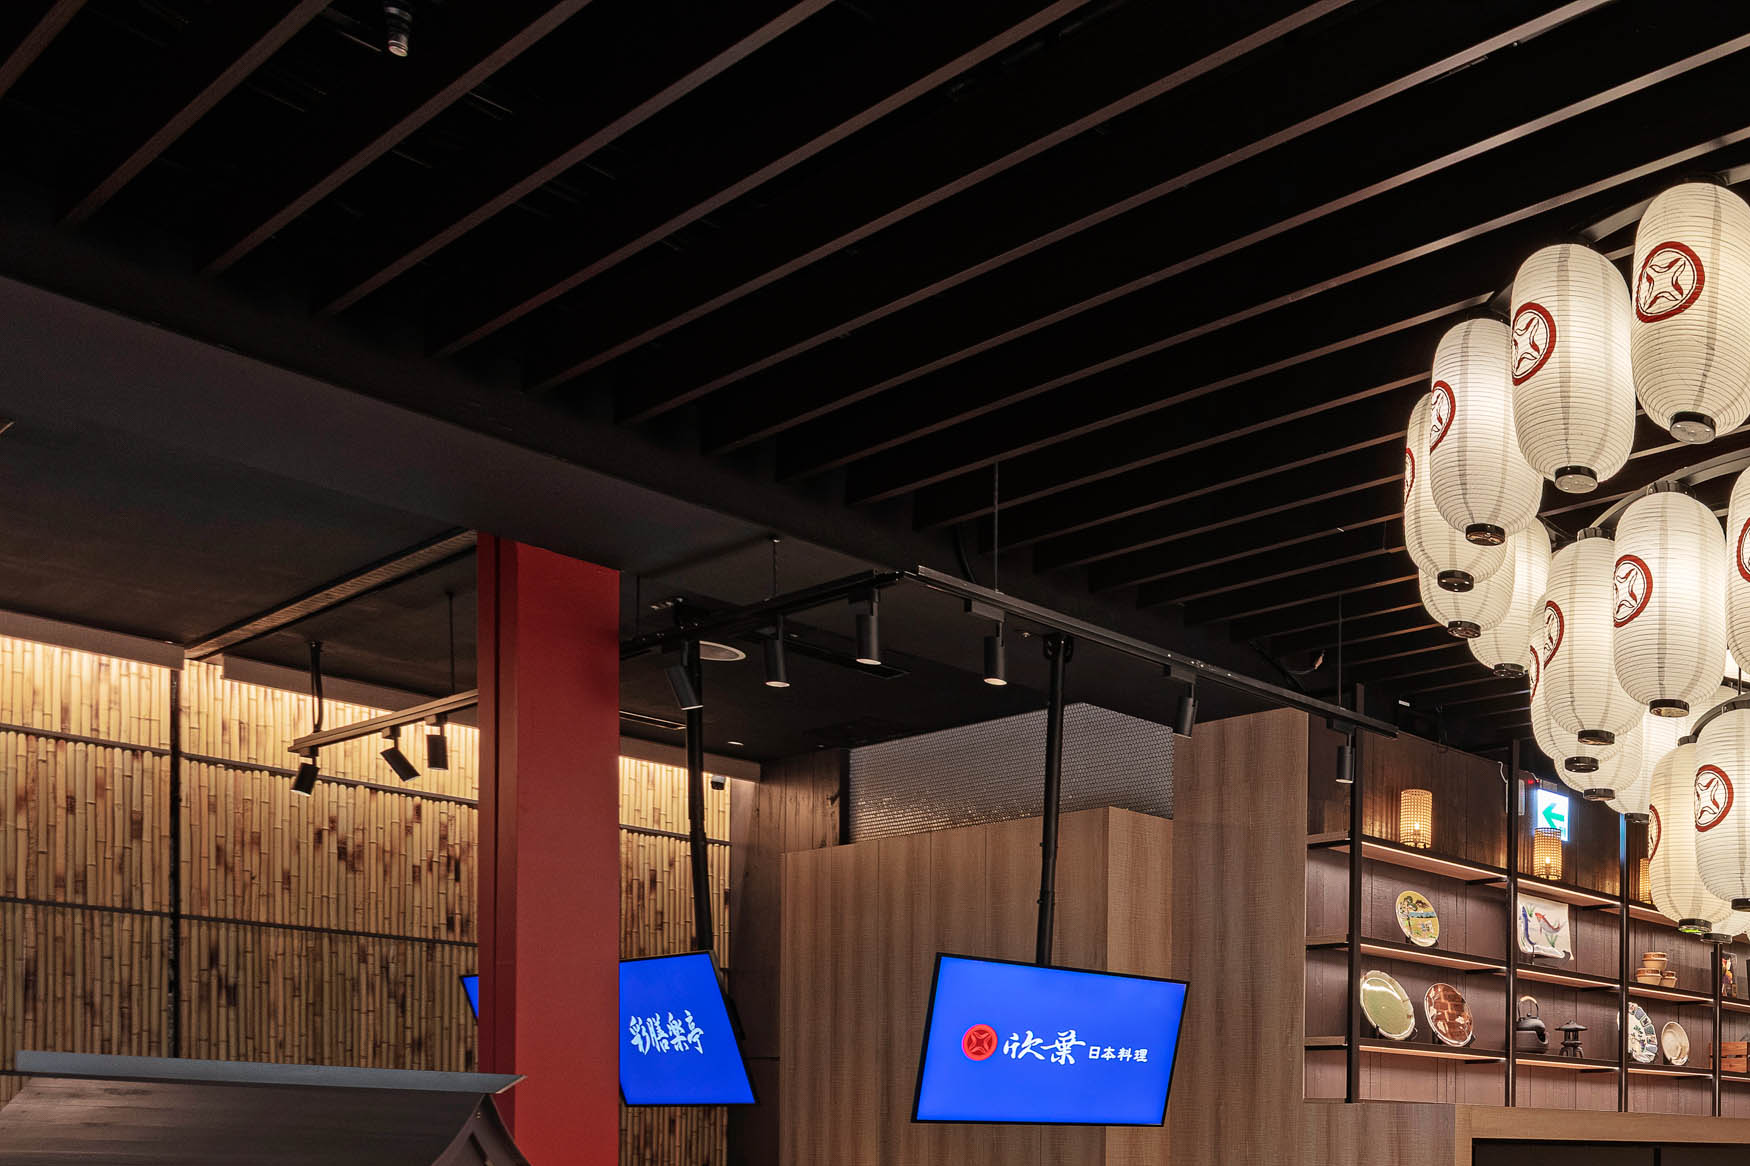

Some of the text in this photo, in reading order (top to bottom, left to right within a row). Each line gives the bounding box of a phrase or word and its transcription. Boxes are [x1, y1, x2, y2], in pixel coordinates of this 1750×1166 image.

[1002, 1029, 1148, 1065] 欣葉 日本料理
